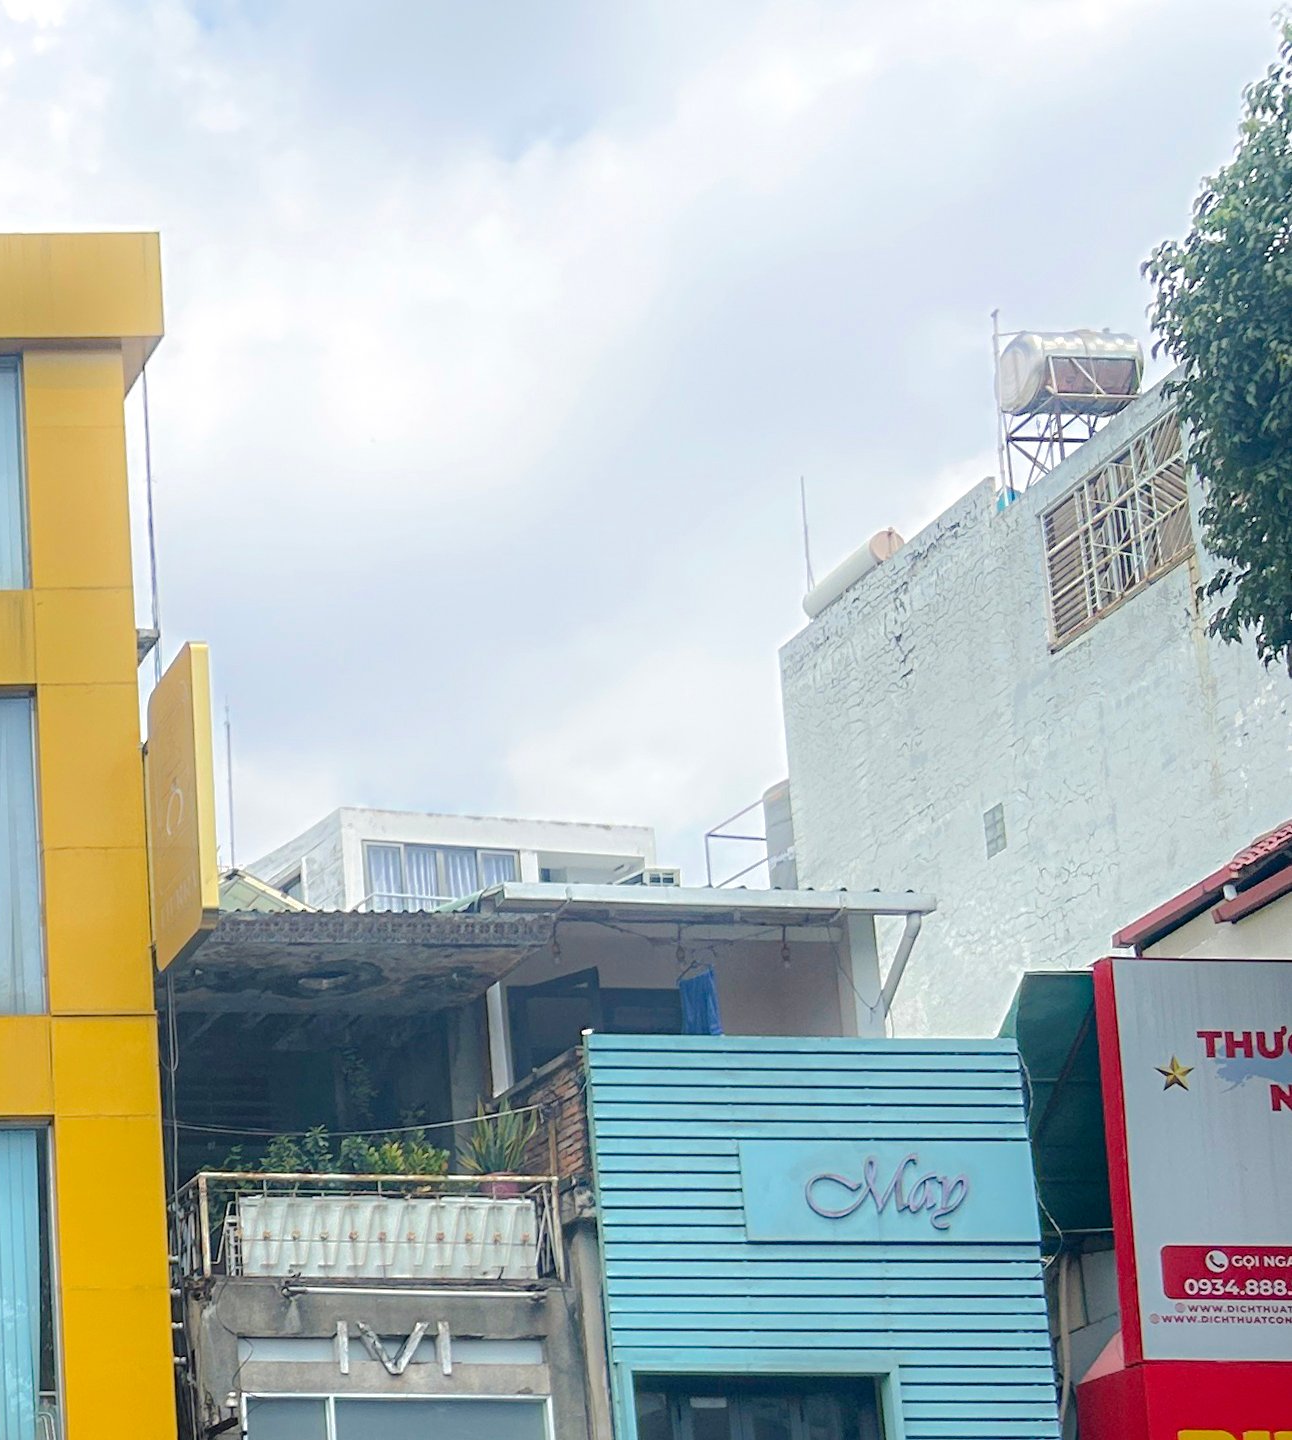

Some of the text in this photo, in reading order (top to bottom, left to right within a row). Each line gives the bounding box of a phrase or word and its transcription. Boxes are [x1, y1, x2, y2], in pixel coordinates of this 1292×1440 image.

[1197, 1026, 1292, 1060] THƯ
[805, 1153, 968, 1231] May
[1231, 1255, 1259, 1270] GỌI
